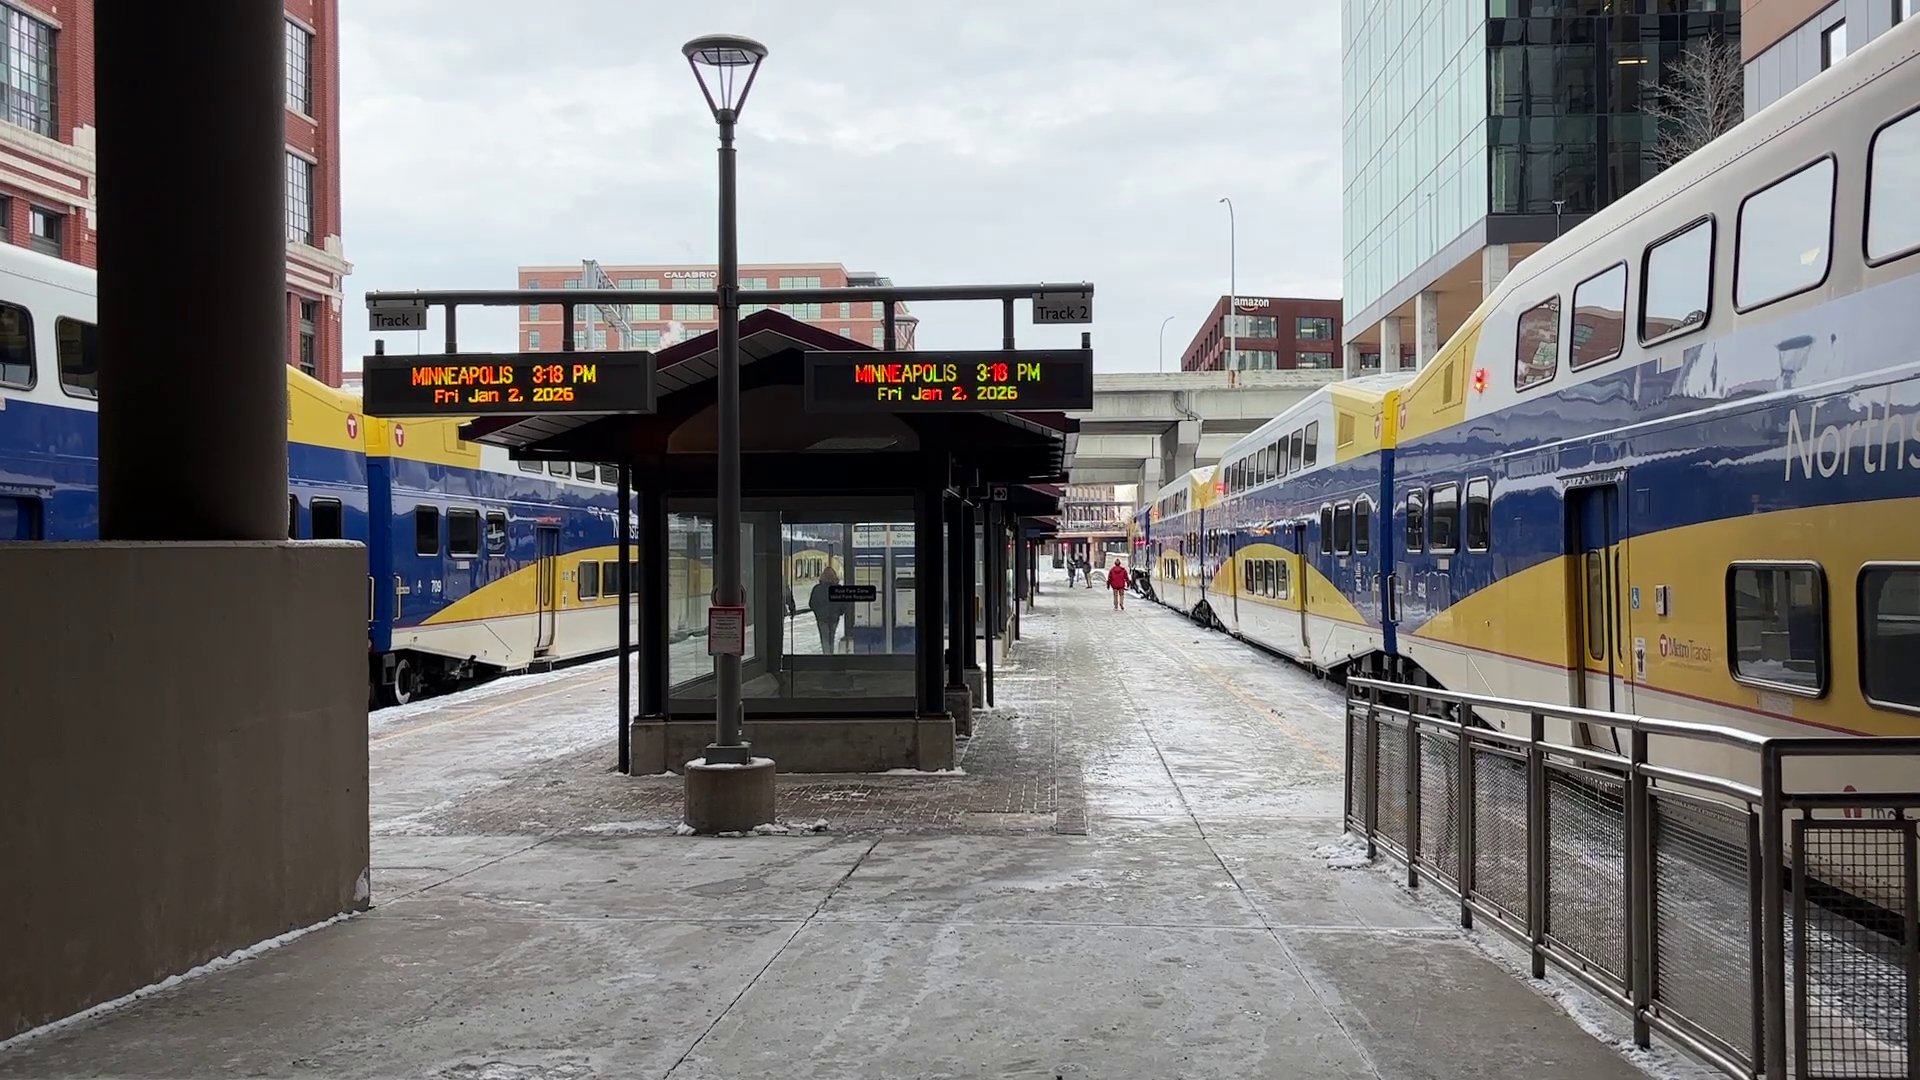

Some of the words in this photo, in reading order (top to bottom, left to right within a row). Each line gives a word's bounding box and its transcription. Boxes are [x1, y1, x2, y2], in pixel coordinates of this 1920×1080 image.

[663, 271, 717, 279] CALABRIO
[1234, 297, 1270, 308] amazon
[373, 313, 410, 327] Track
[1037, 305, 1075, 320] Track
[1080, 305, 1089, 319] 2
[412, 366, 513, 385] MINNEAPOLIS
[533, 364, 564, 384] 3:18
[573, 364, 596, 383] PM
[855, 363, 957, 383] MINNEAPOLIS
[977, 363, 1008, 382] 3:18
[1017, 362, 1041, 382] PM
[434, 388, 459, 403] Fri
[468, 388, 499, 403] Jan
[508, 387, 524, 402] 2,
[533, 387, 574, 402] 2026
[877, 386, 902, 401] Fri
[911, 386, 943, 401] Jan
[952, 386, 968, 401] 2,
[977, 385, 1018, 401] 2026
